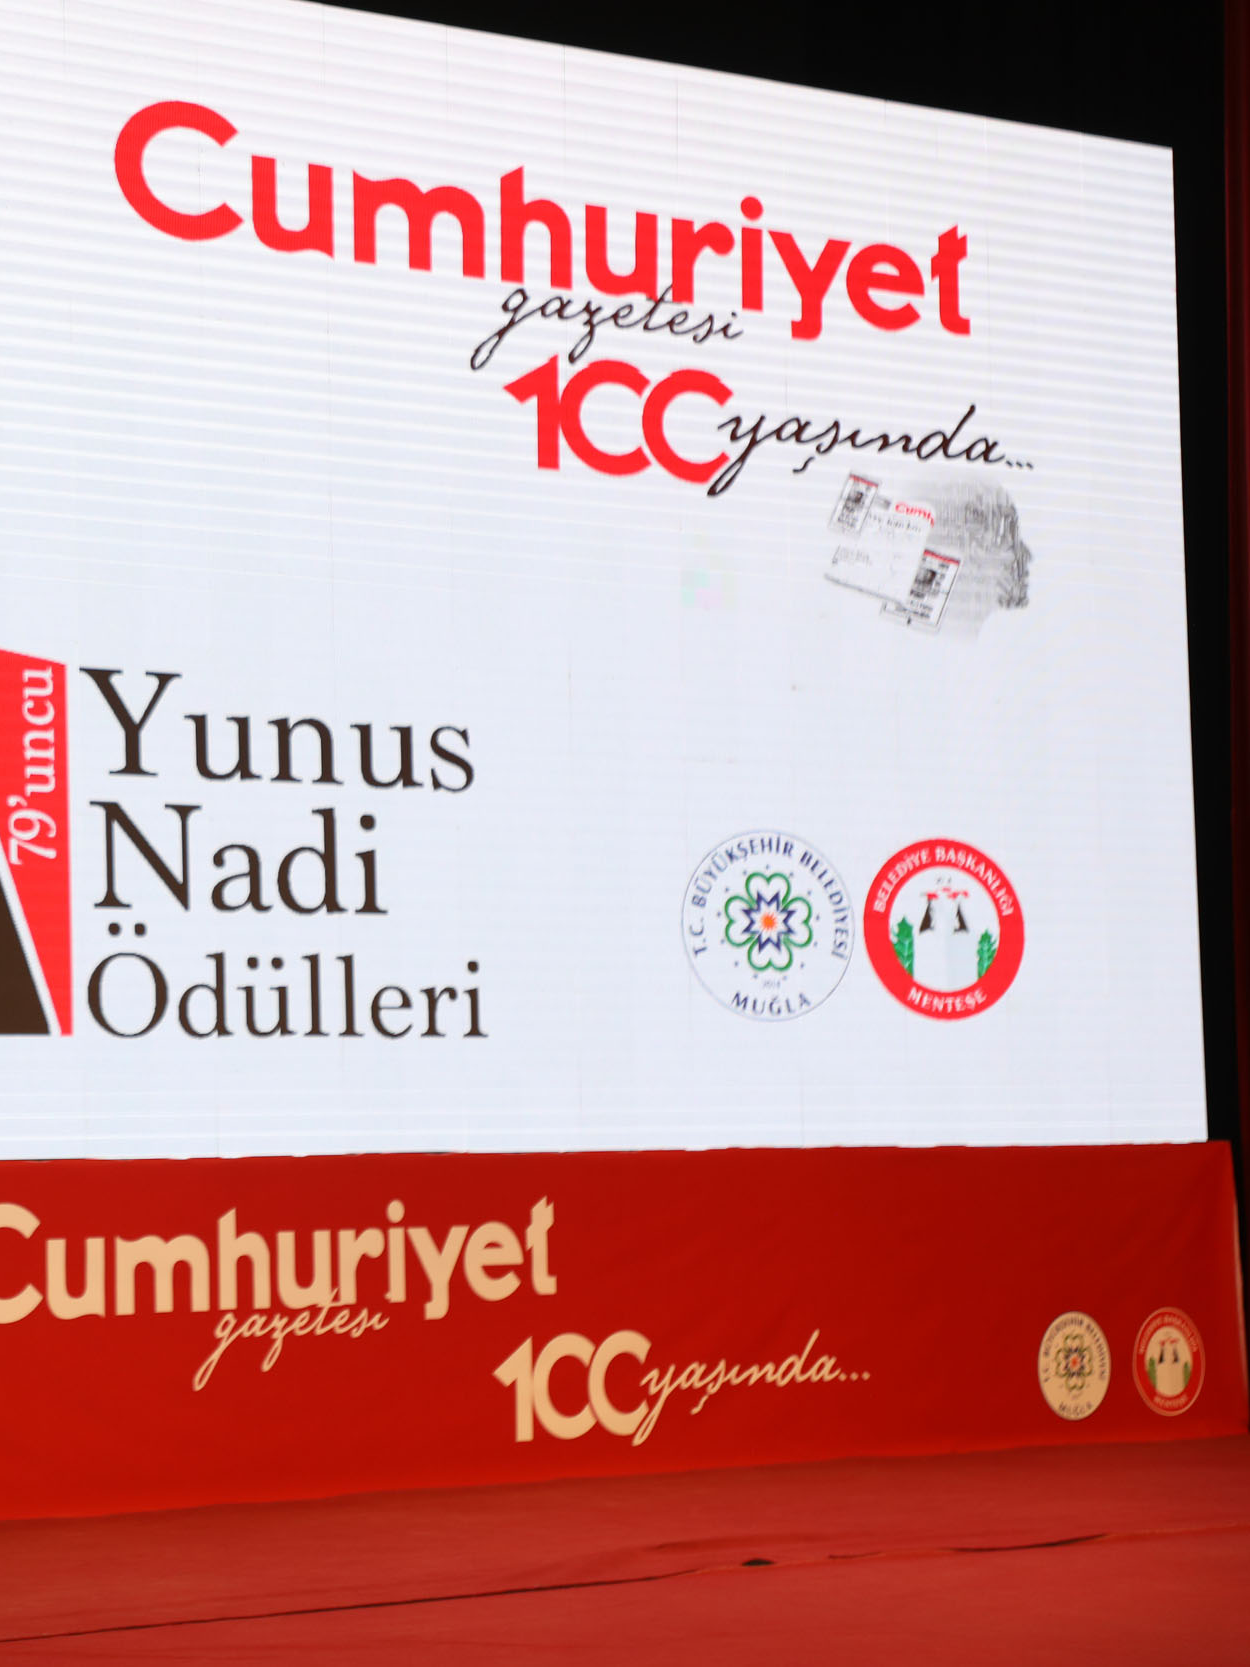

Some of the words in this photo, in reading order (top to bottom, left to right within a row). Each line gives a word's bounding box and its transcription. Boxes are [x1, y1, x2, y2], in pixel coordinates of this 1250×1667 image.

[115, 99, 971, 341] Cumhuriyet
[470, 286, 743, 370] gazetesi
[79, 667, 475, 792] Yunus
[89, 801, 389, 915] Nadi
[87, 922, 489, 1038] Ödülleri
[730, 991, 812, 1016] MUĞLA
